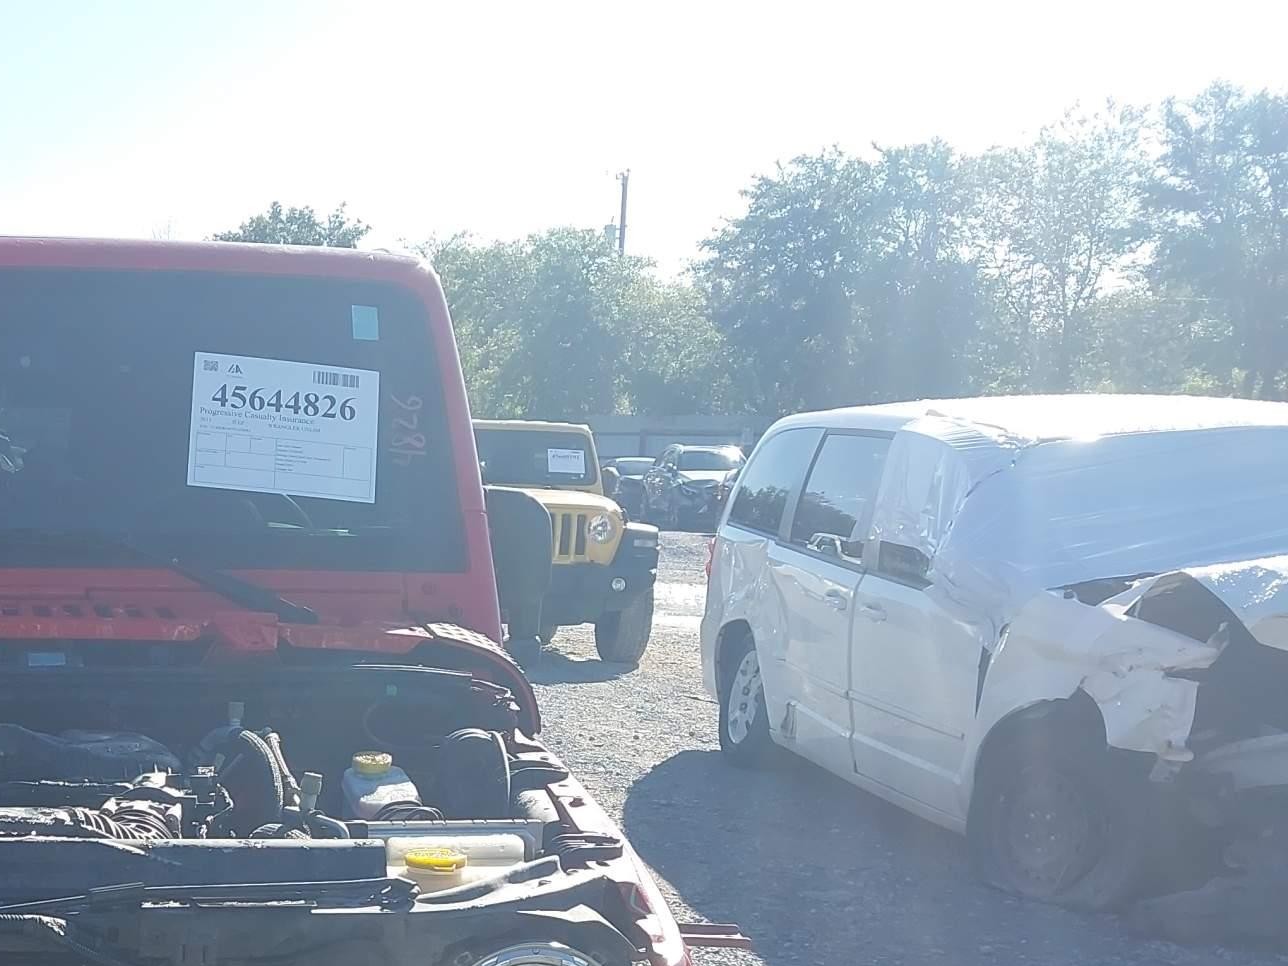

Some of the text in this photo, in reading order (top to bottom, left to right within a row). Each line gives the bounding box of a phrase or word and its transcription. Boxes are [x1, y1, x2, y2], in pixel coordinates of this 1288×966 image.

[199, 406, 315, 425] Progressive Casualty Insurance
[212, 384, 361, 421] 45644826
